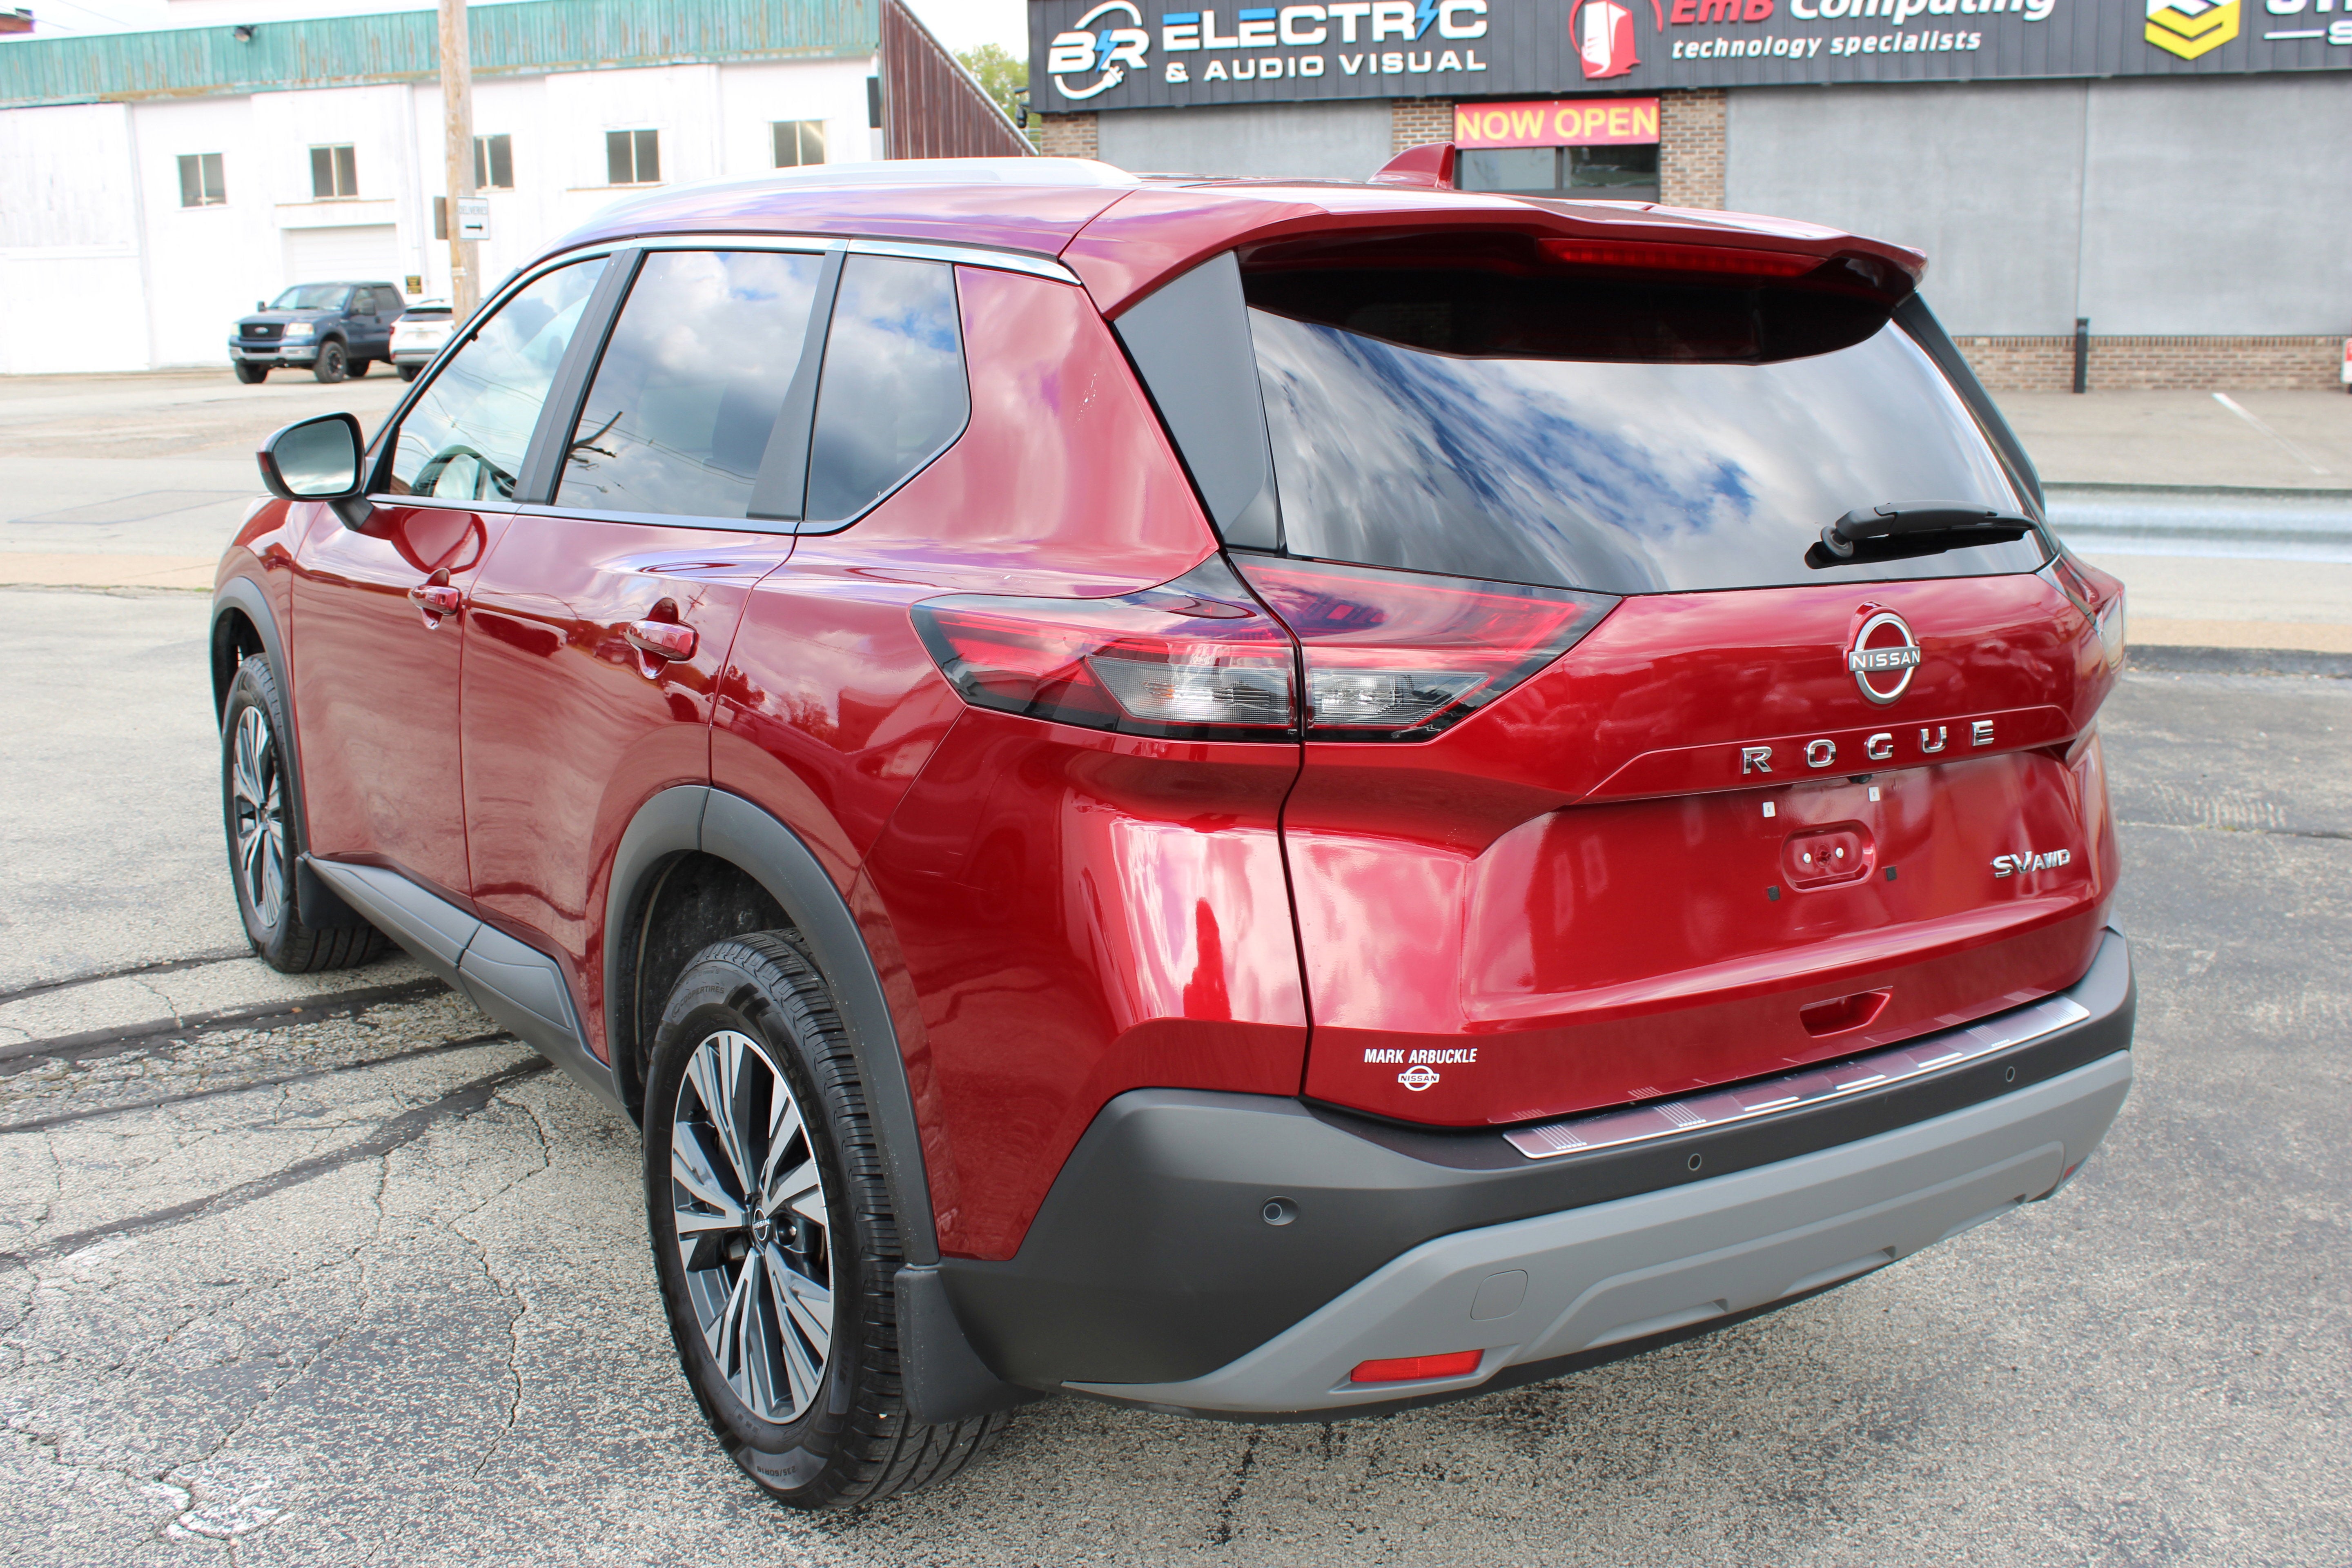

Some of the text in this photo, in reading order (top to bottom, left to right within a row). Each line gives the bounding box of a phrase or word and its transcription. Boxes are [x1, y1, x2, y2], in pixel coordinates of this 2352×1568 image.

[1672, 30, 1982, 59] technology specialists
[1166, 49, 1487, 83] & AUDIO VISUAL
[1456, 106, 1658, 141] NOW OPEN
[1852, 650, 1920, 668] NISSAN
[1742, 719, 1995, 775] ROGUE
[1364, 1048, 1478, 1064] MARK ARBUCKLE
